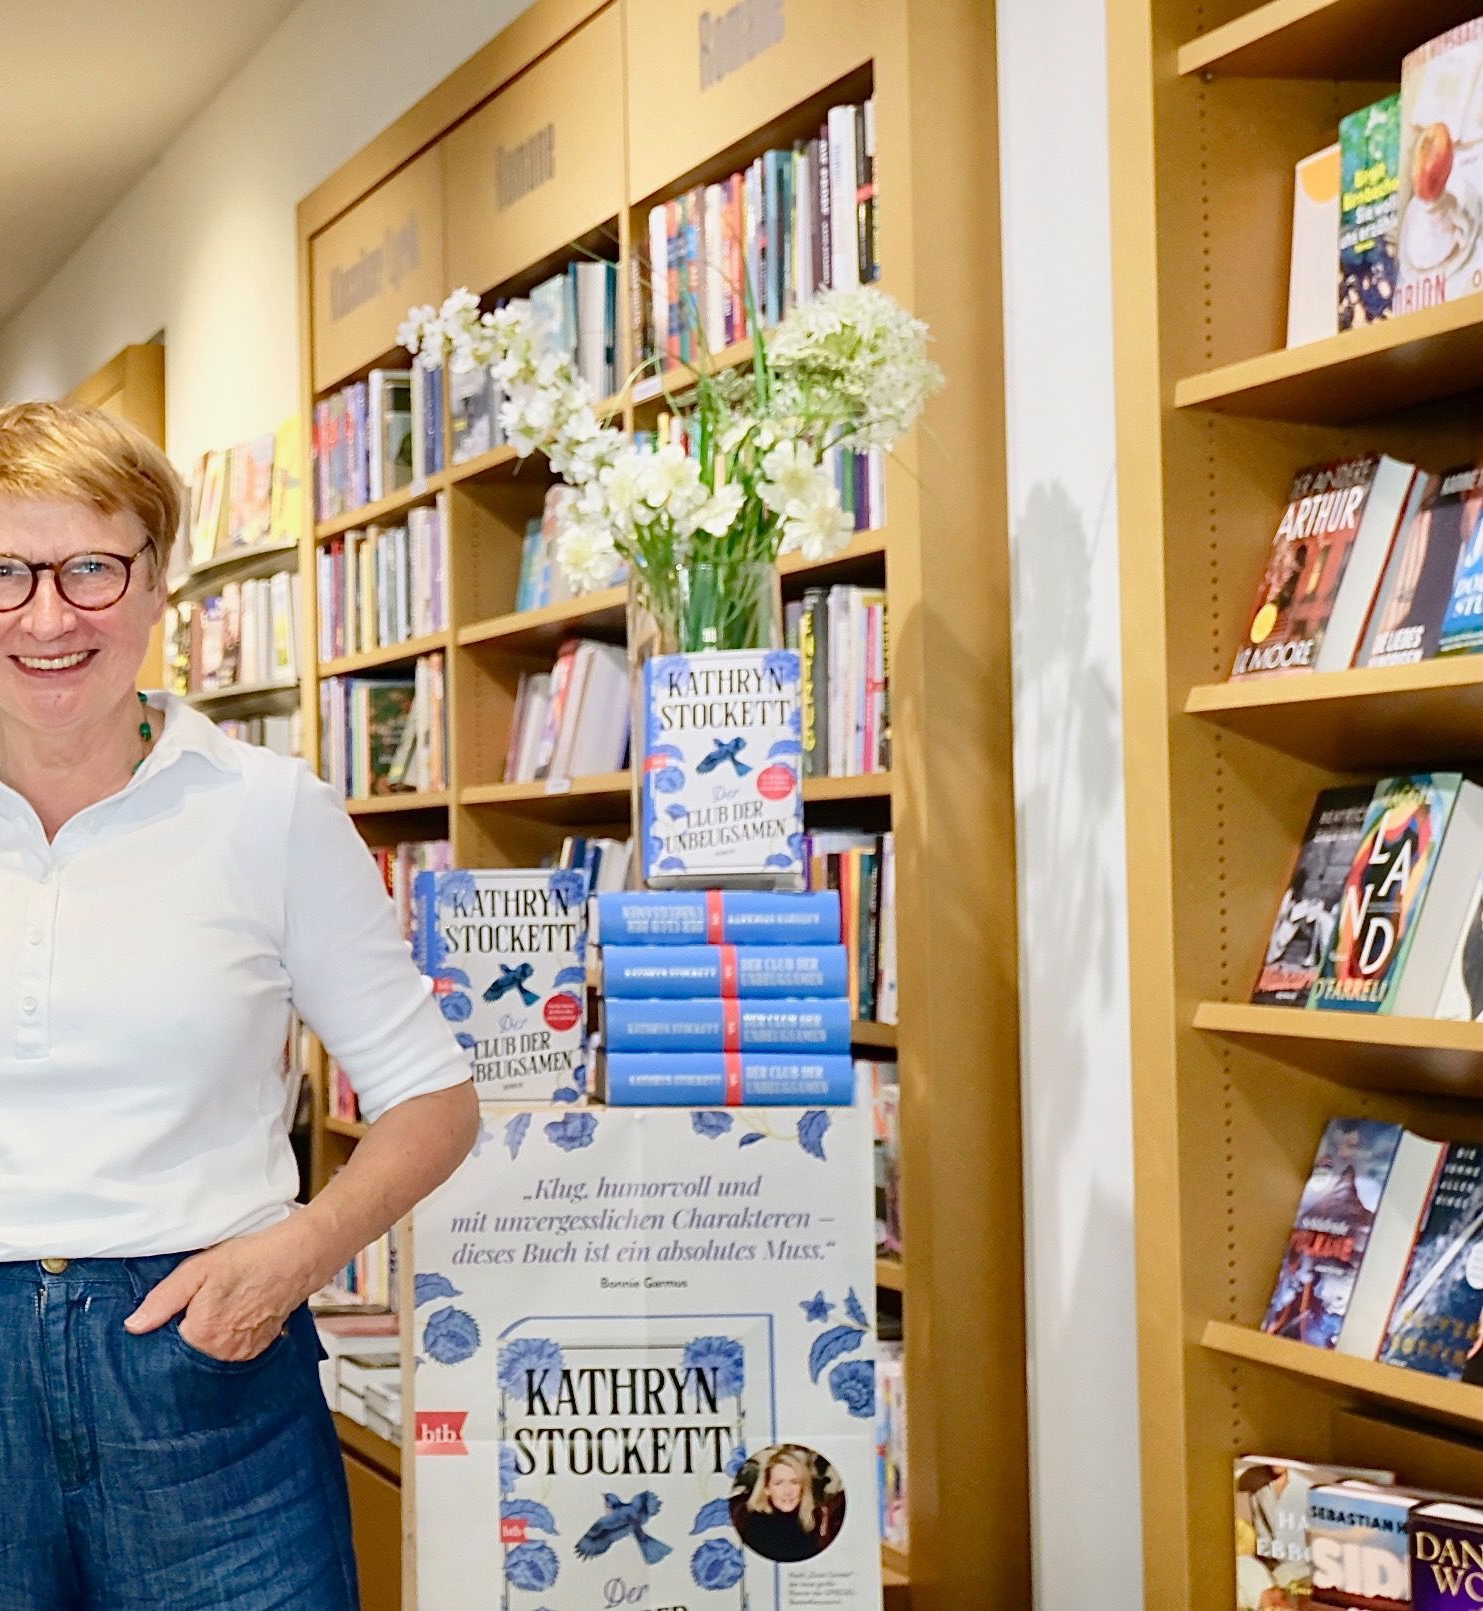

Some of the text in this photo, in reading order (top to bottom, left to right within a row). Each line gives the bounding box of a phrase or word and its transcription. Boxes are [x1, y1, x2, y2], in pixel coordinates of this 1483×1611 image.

[1273, 485, 1365, 545] ARTHUR
[667, 667, 784, 698] KATHRYN
[660, 700, 790, 731] STOCKETT
[685, 800, 764, 830] CLUB DER
[665, 819, 786, 855] UNBEUGSAMEN
[454, 889, 569, 919] KATHRYN
[445, 924, 577, 955] STOCKETT
[474, 1031, 551, 1060] CLUB DER
[471, 1051, 573, 1083] BEUGSAMEN
[597, 1175, 712, 1198] humorvoll
[718, 1175, 762, 1197] und
[450, 1212, 487, 1233] mit
[493, 1209, 665, 1236] unvergesslichen
[672, 1207, 811, 1230] Charakteren
[452, 1243, 515, 1265] dieses
[522, 1241, 578, 1264] Buch
[584, 1241, 611, 1262] ist
[616, 1240, 650, 1262] ein
[656, 1239, 757, 1261] absolutes
[600, 1277, 688, 1289] Bonnie Garmus
[525, 1367, 719, 1416] KATHRYN
[421, 1424, 457, 1444] btb
[514, 1427, 731, 1476] STOCKETT
[1310, 1505, 1395, 1533] SEBASTIAN
[604, 1578, 649, 1609] Der
